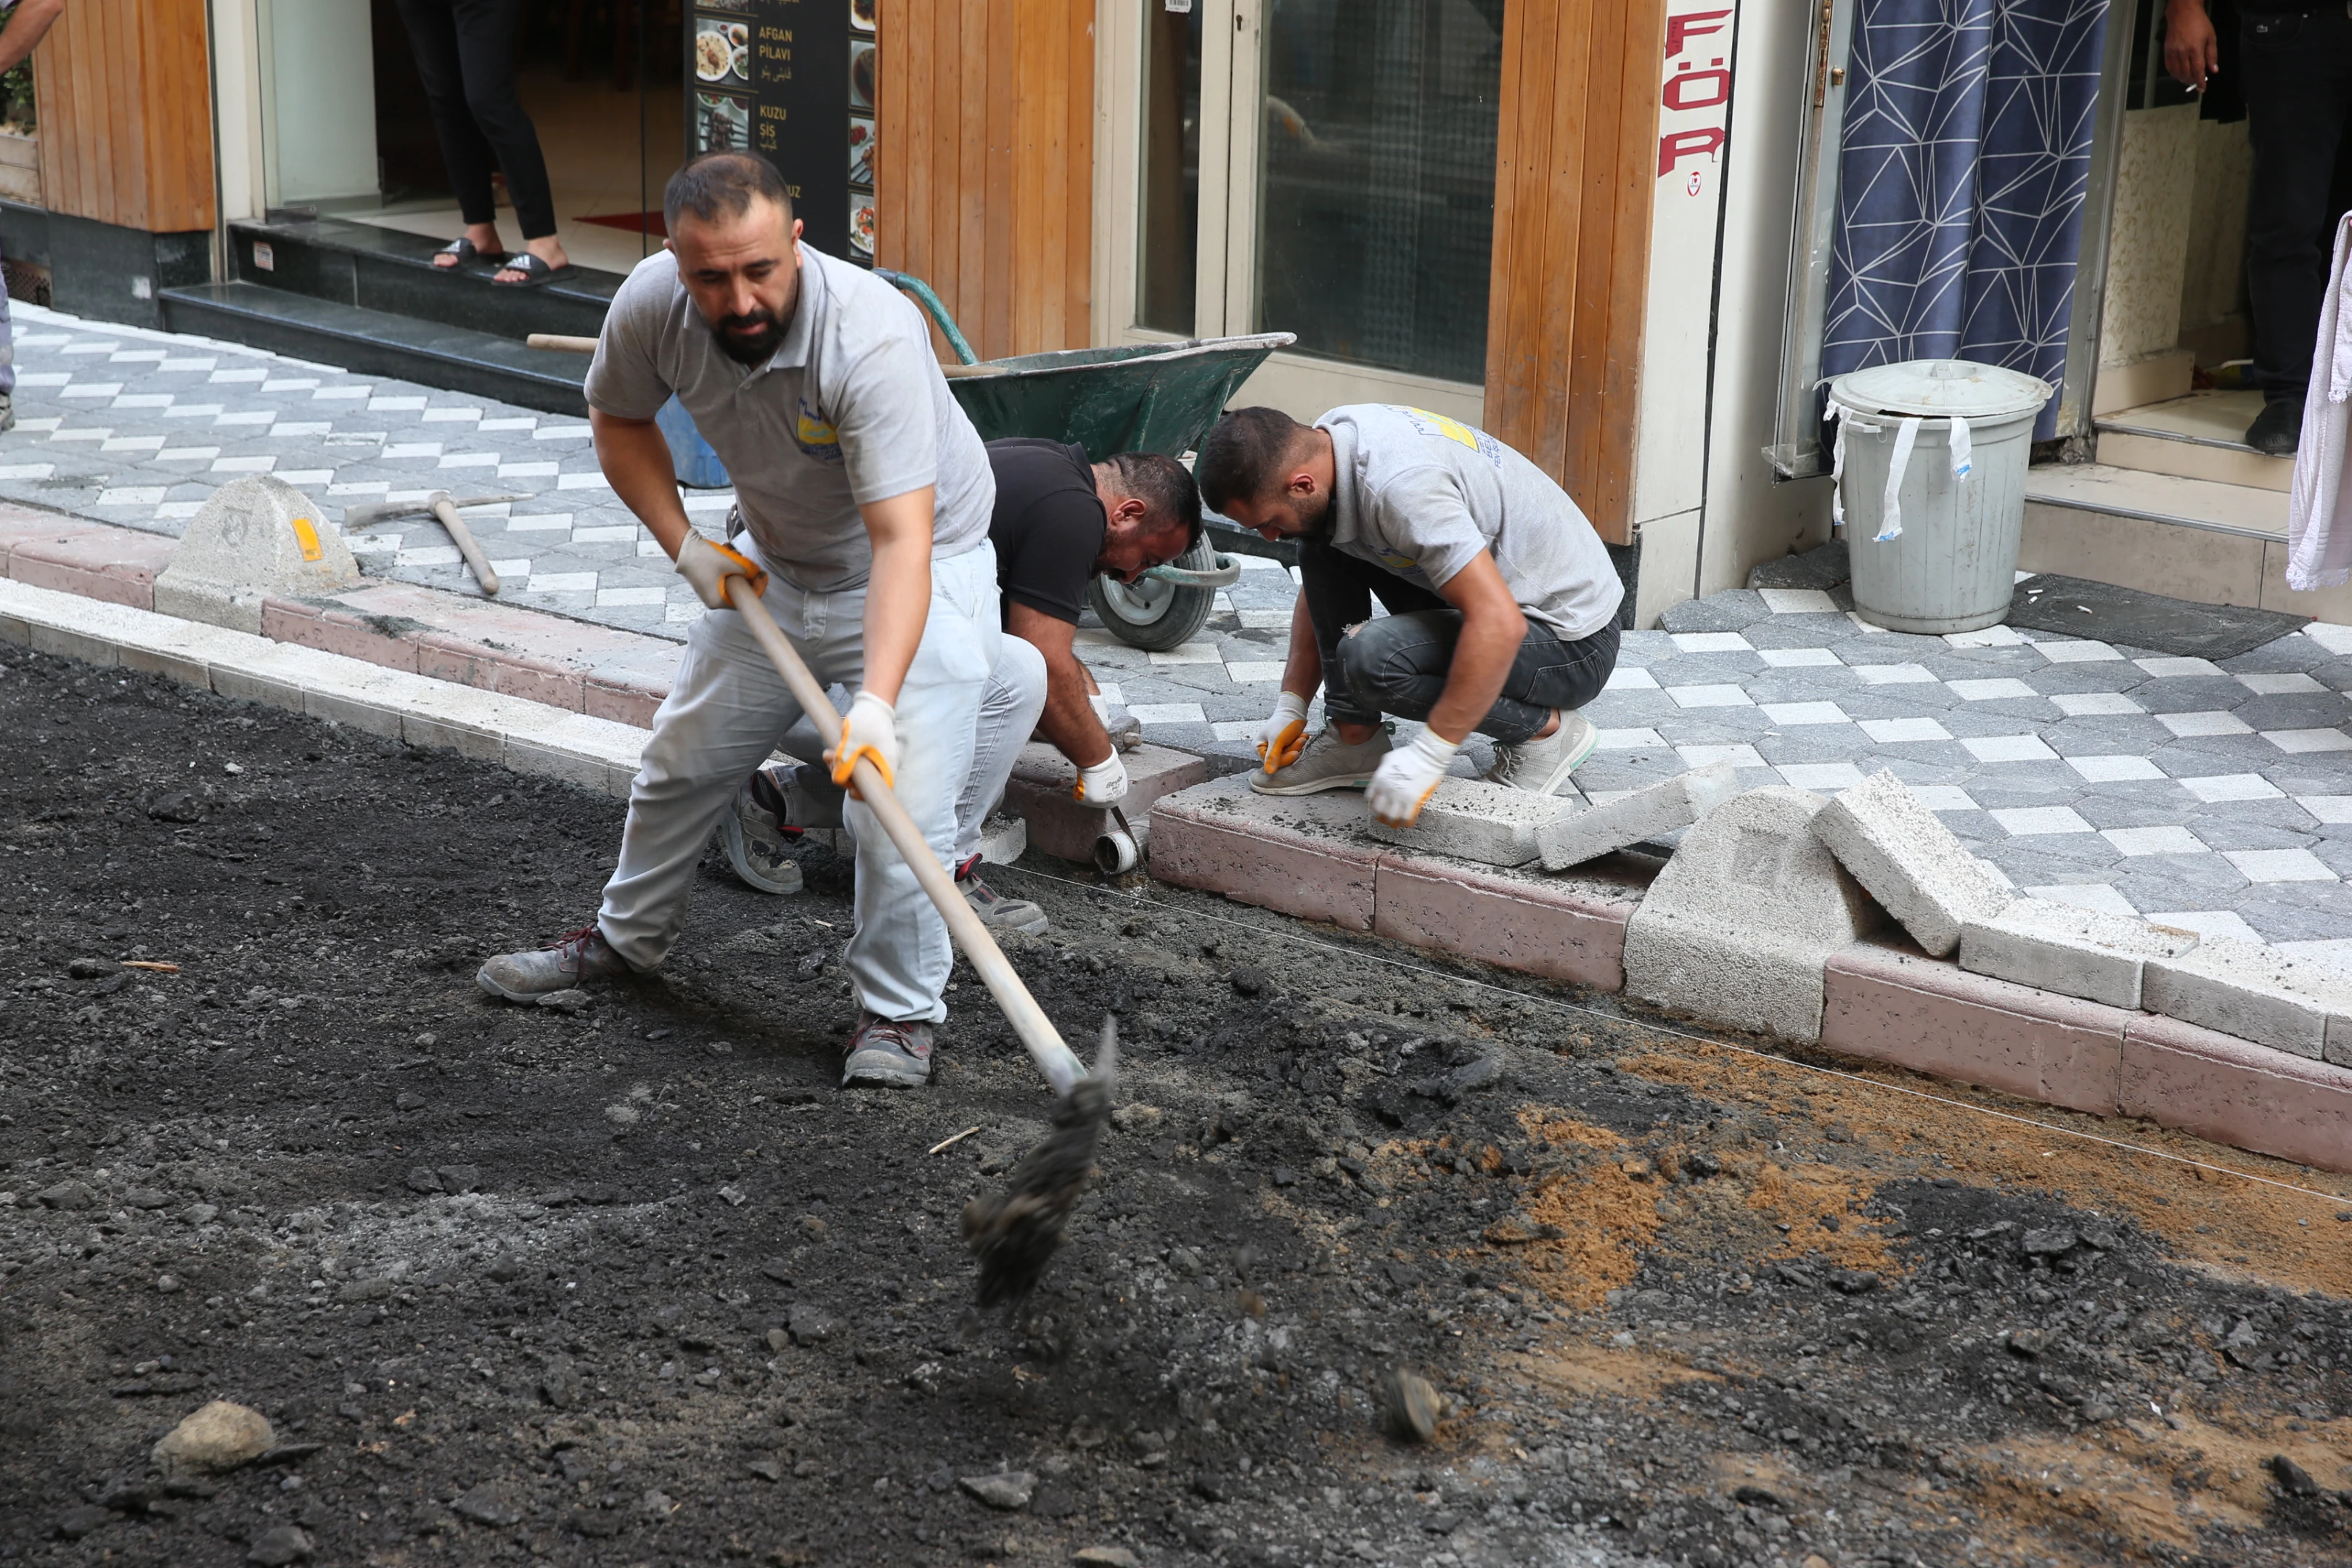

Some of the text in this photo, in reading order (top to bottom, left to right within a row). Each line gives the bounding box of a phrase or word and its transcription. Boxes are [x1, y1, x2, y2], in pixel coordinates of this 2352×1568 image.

[759, 26, 793, 43] AFGAN
[759, 44, 791, 62] PİLAVI
[759, 105, 787, 121] KUZU
